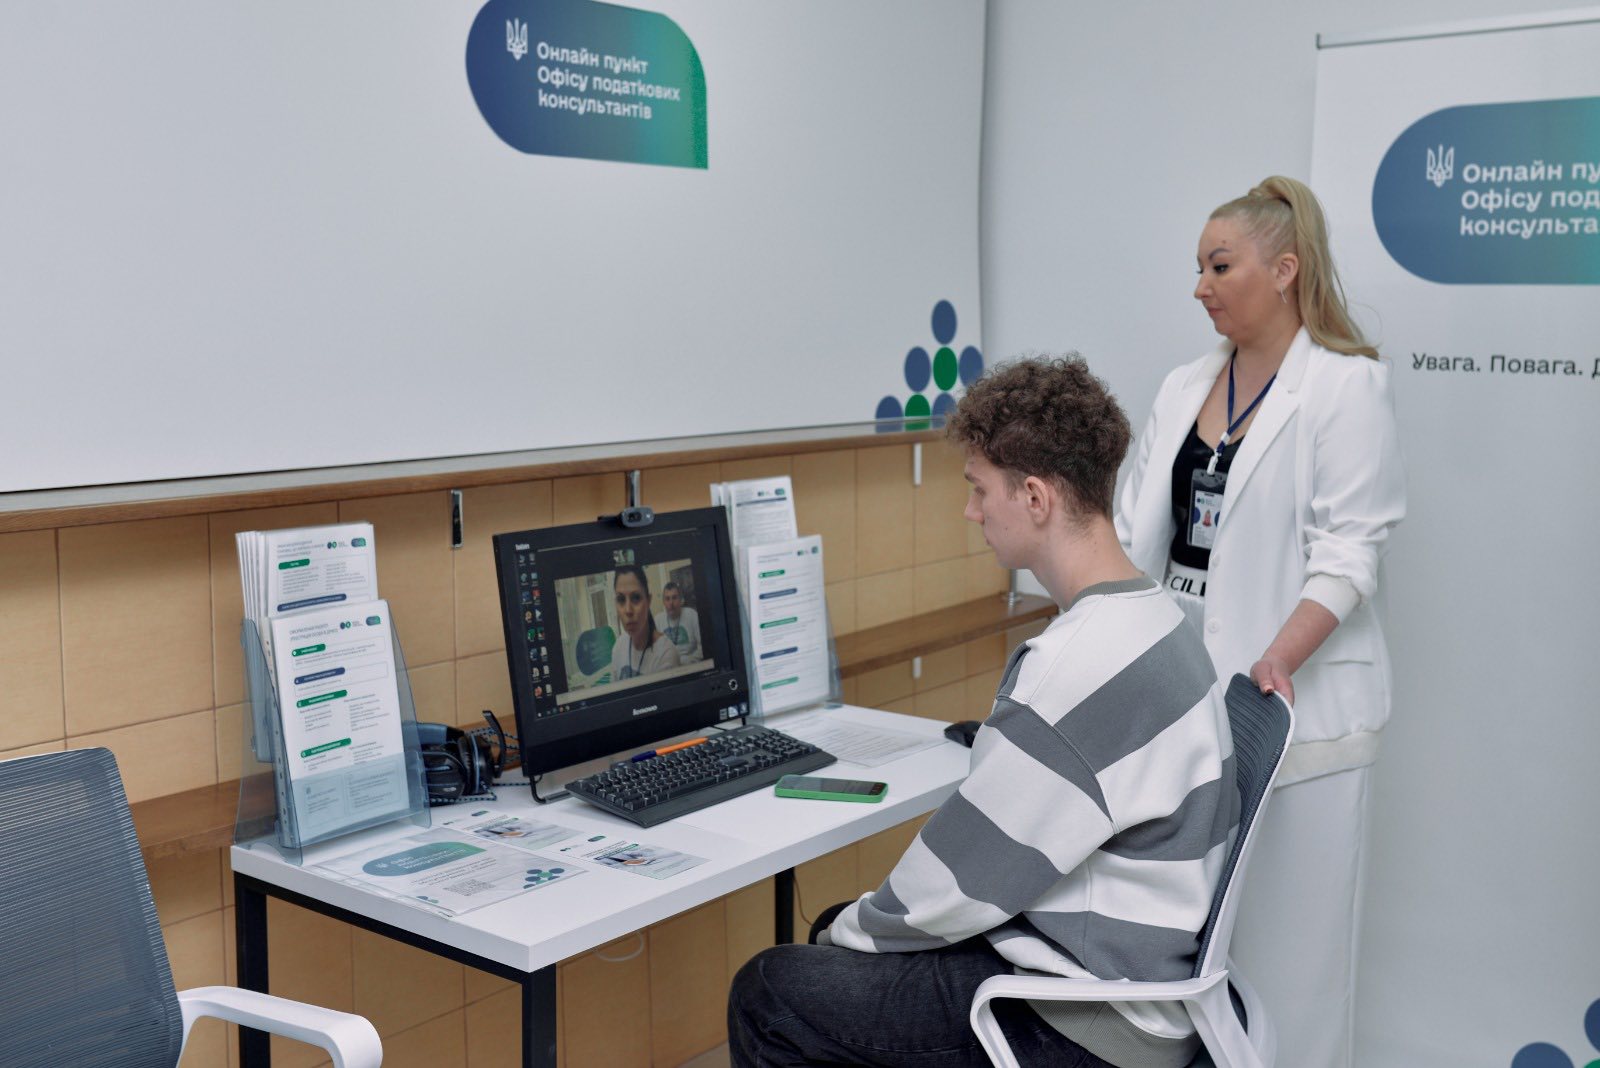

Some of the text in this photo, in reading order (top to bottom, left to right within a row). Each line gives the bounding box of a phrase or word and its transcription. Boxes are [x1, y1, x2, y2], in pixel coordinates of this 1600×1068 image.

[537, 41, 649, 74] Онлайн пункт
[537, 66, 681, 102] Офісу податкових
[538, 88, 652, 120] консультантів
[1462, 160, 1562, 184] Онлайн
[1461, 188, 1542, 213] Офісу
[1460, 215, 1598, 240] консульта
[1412, 352, 1481, 372] Увага.
[1490, 354, 1583, 377] Повага.
